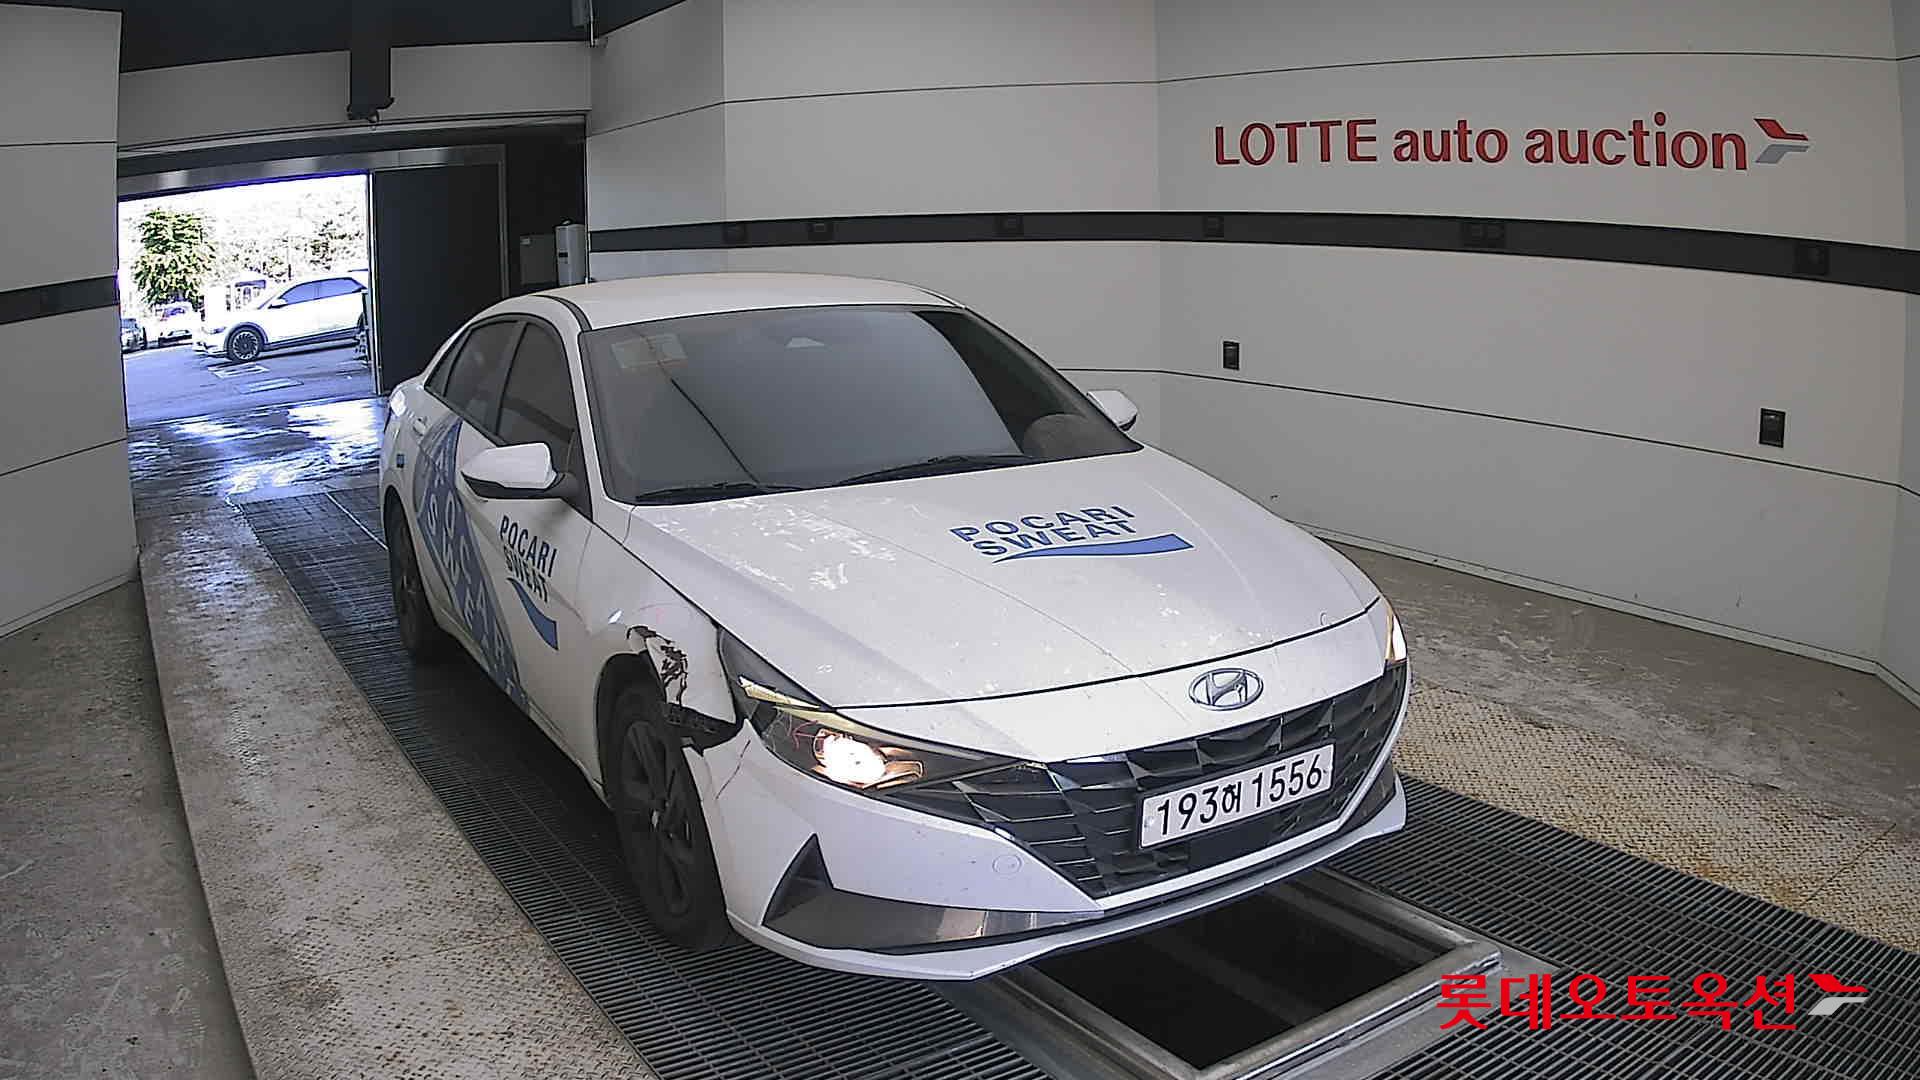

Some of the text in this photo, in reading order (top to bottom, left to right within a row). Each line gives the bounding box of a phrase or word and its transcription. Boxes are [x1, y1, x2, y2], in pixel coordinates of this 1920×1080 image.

[1214, 111, 1748, 171] LOTTE auto auction
[500, 515, 557, 578] POCARI
[950, 505, 1135, 542] POCARI
[972, 520, 1136, 556] SWEAT
[503, 546, 549, 603] SWEAT
[1251, 753, 1323, 808] 1556
